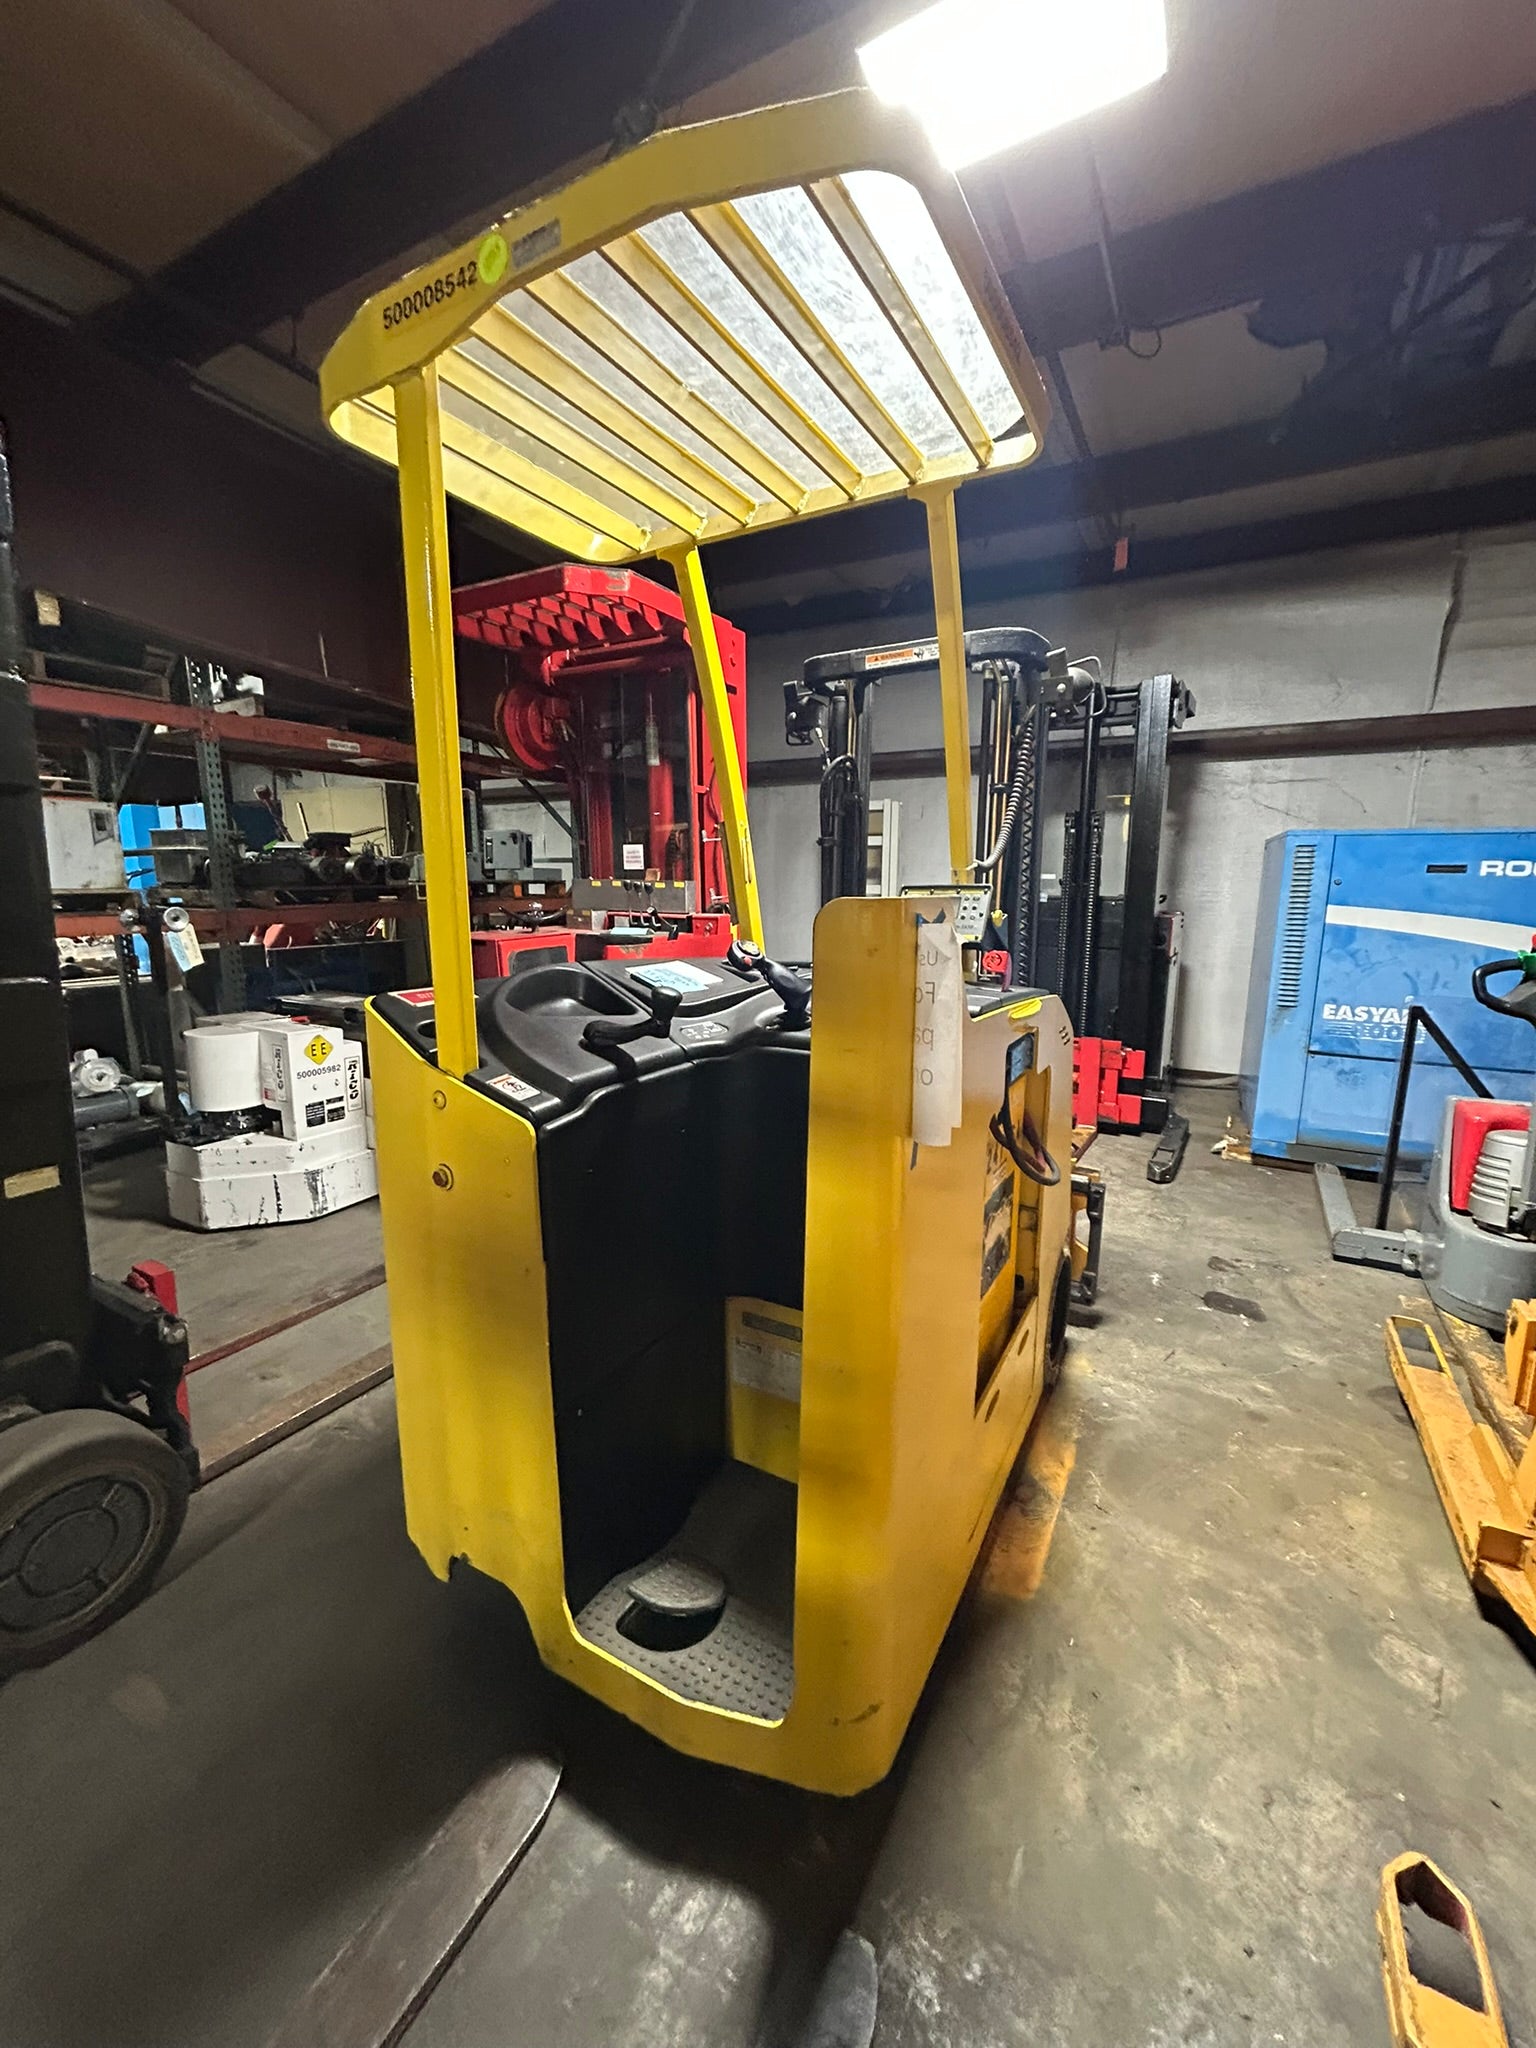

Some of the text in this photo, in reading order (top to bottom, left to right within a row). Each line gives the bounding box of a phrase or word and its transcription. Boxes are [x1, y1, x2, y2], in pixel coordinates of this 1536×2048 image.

[384, 261, 477, 329] 500008542
[1480, 860, 1536, 877] RO
[297, 1064, 341, 1079] 500005982
[347, 1060, 358, 1100] RICO
